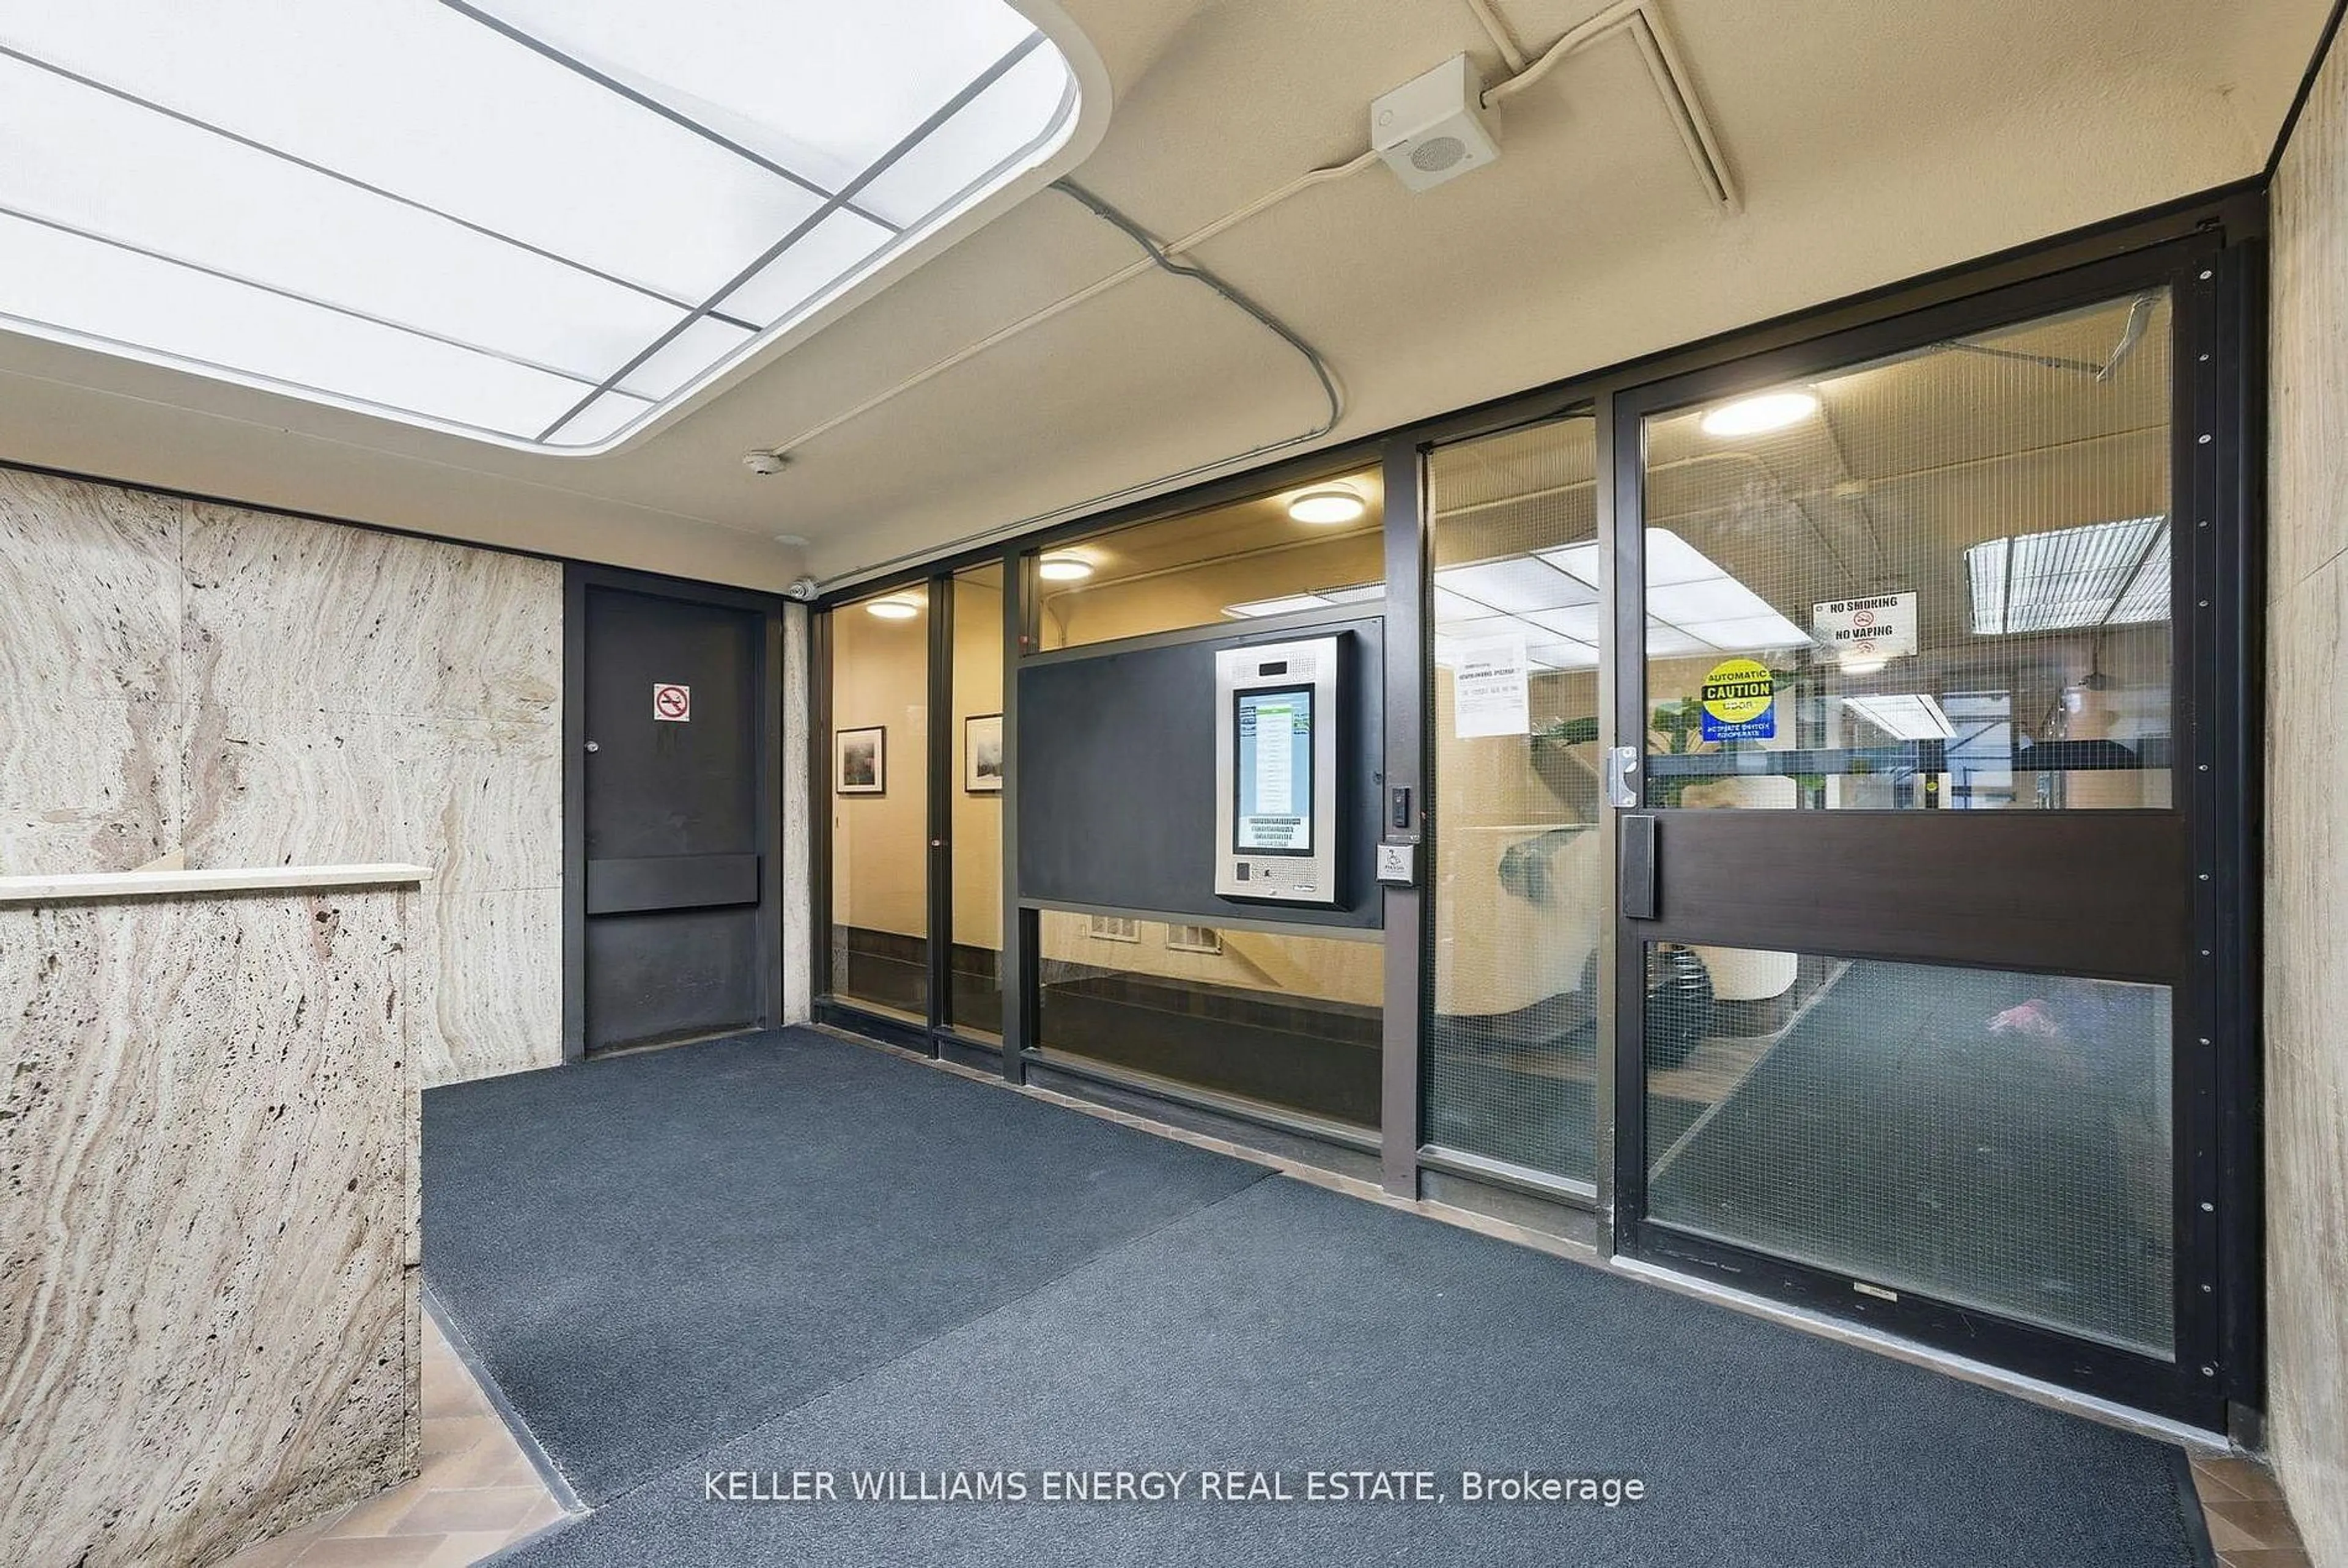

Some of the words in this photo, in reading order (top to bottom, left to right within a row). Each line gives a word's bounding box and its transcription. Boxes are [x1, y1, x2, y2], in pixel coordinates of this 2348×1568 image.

[1831, 604, 1844, 613] NO
[1847, 597, 1898, 611] SMOKING
[1836, 630, 1850, 640] NO
[1853, 625, 1893, 638] VAPING
[1708, 670, 1767, 682] AUTOMATIC
[1707, 683, 1770, 699] CAUTION
